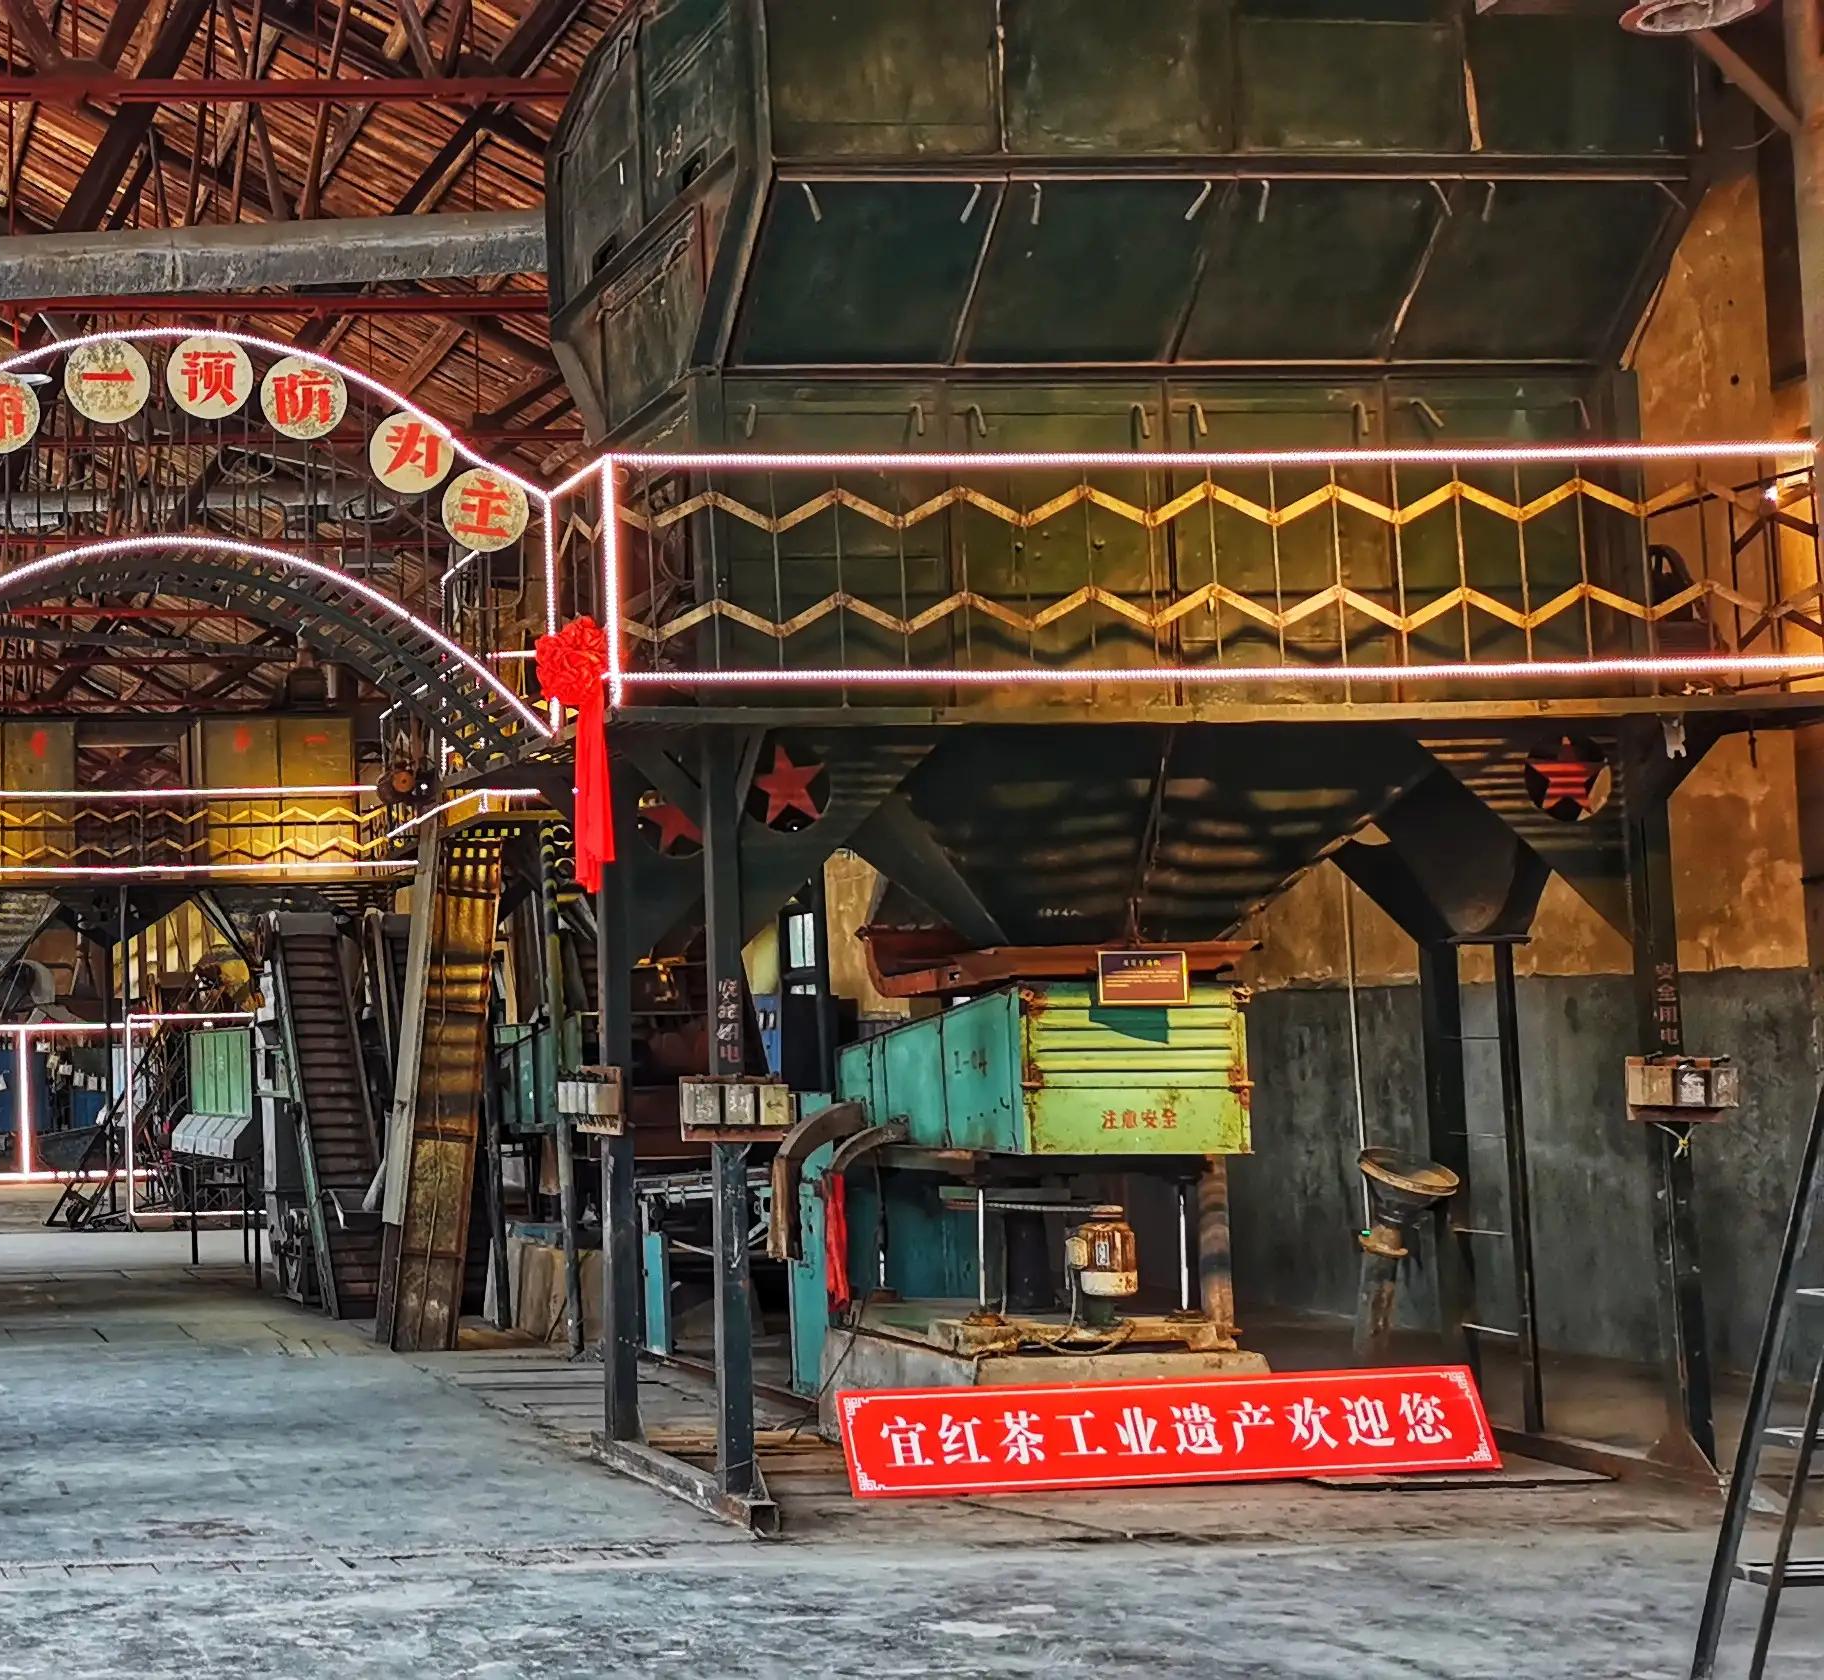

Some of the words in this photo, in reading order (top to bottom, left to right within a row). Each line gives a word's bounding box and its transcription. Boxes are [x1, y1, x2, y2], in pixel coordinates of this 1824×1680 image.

[1100, 1108, 1178, 1130] 注意安全
[879, 1391, 1454, 1468] 宜红茶工业遗产欢迎您
